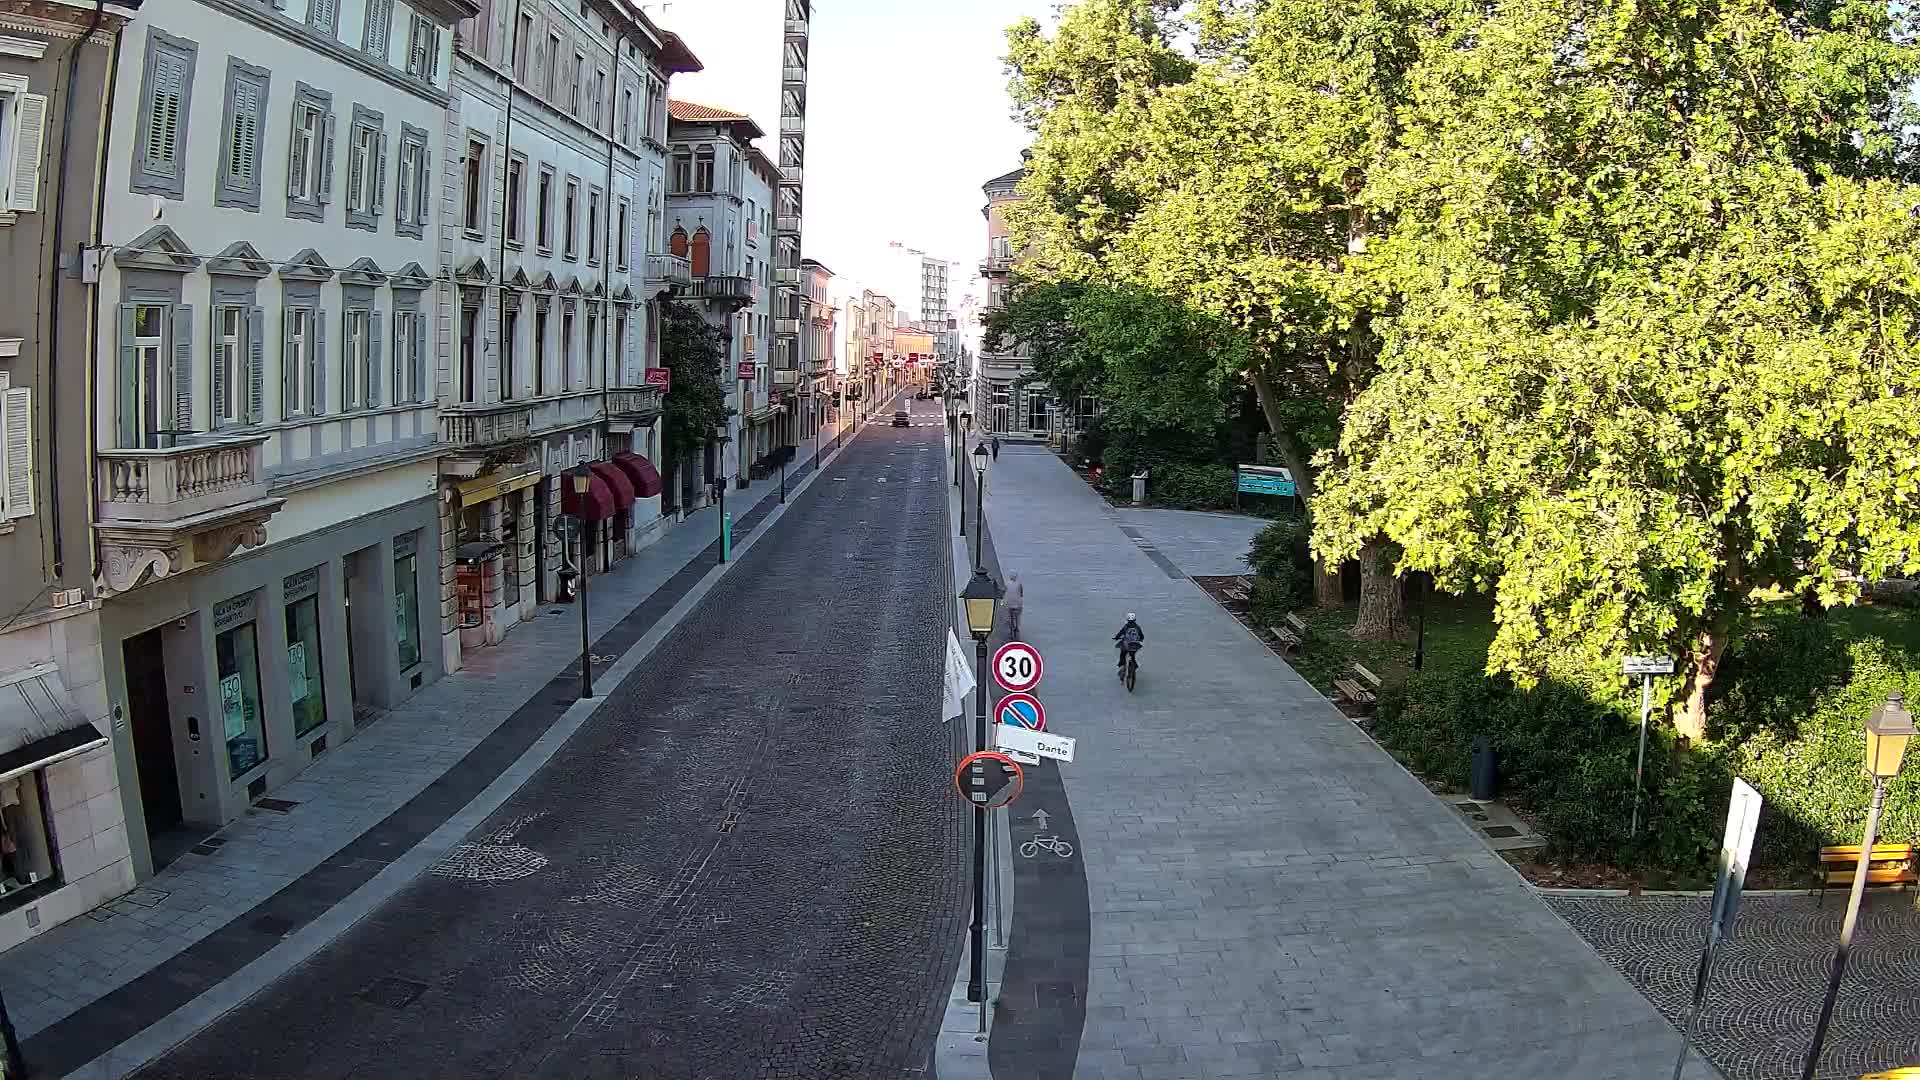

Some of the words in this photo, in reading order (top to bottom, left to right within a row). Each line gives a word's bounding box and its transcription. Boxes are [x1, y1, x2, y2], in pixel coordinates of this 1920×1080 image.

[1005, 656, 1031, 678] 30
[222, 677, 240, 699] 130
[1037, 742, 1068, 755] Dante
